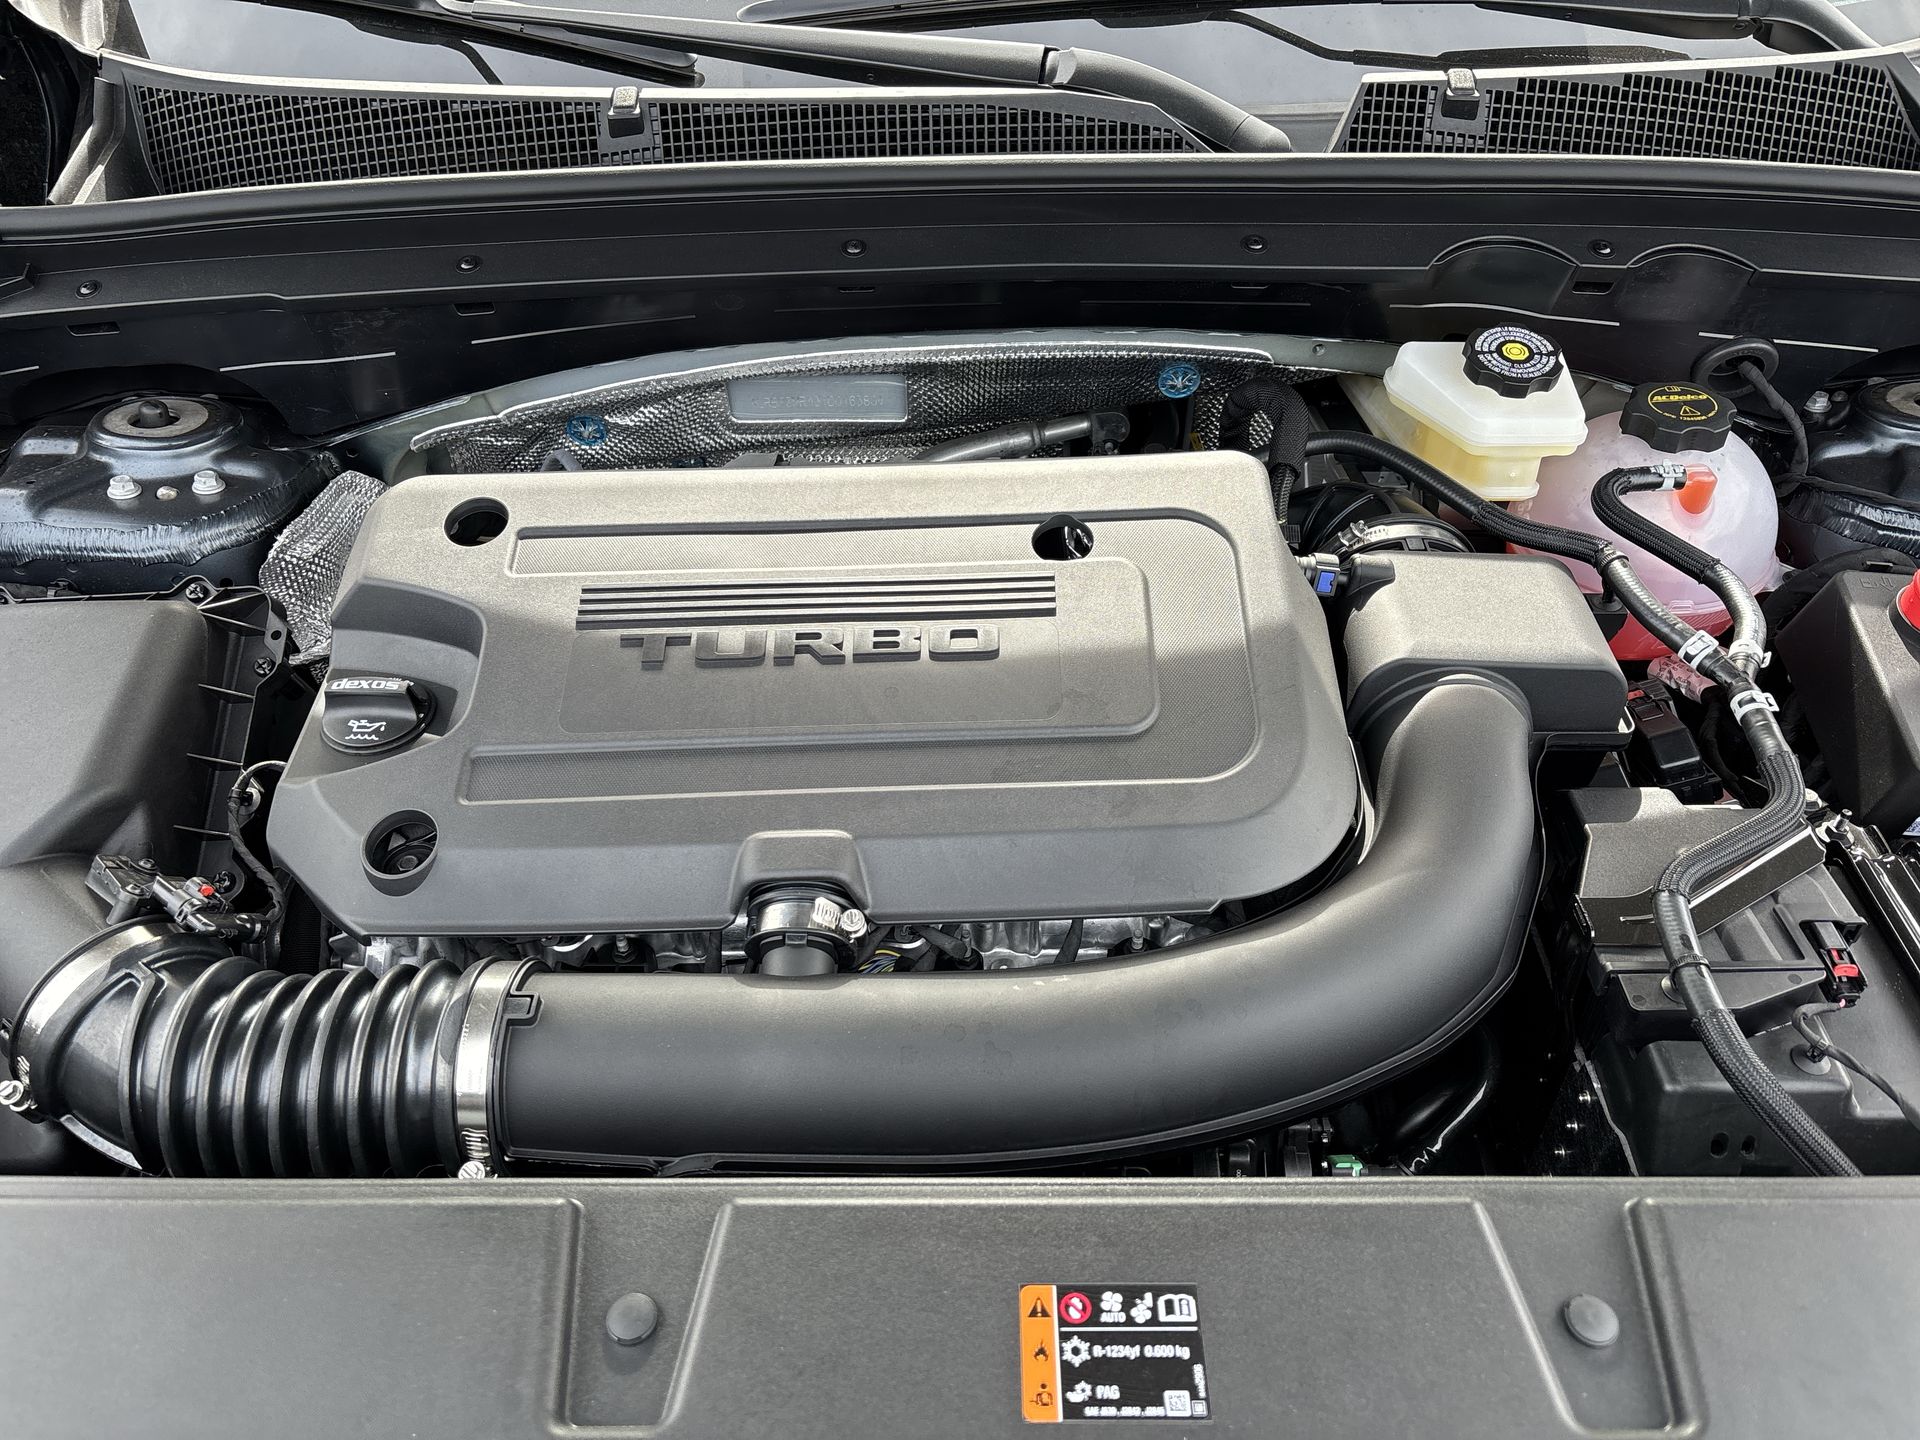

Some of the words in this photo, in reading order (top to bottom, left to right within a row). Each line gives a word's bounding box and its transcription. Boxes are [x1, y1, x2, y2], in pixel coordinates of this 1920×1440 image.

[620, 625, 1000, 670] TURBO
[331, 678, 400, 690] dexos
[1100, 1312, 1126, 1323] AUTO
[1143, 1344, 1175, 1358] 0.600
[1175, 1344, 1191, 1360] kg
[1095, 1384, 1120, 1400] PAG
